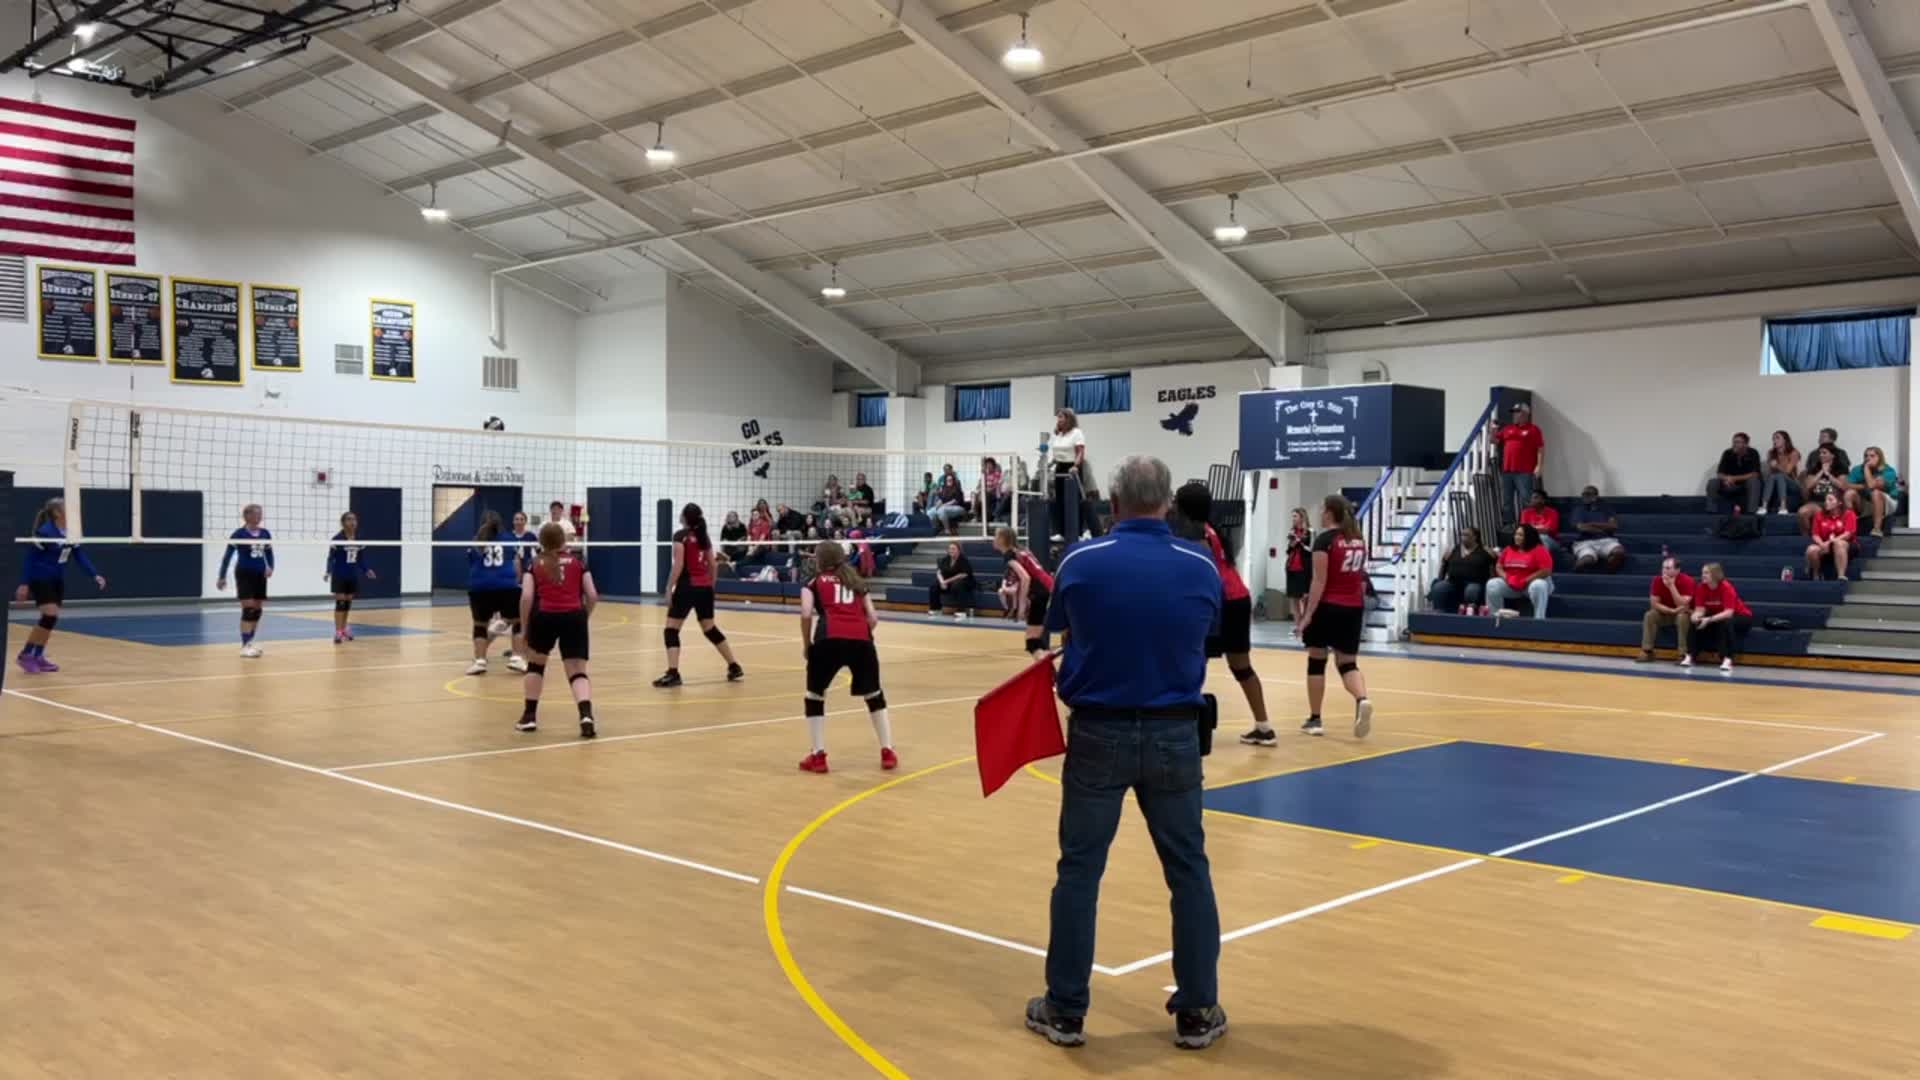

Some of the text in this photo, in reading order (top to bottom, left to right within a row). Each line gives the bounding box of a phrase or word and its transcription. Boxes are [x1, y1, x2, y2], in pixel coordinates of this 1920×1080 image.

[176, 297, 237, 313] CHAMPIONS
[1158, 385, 1216, 403] EAGLES
[741, 419, 760, 440] GO
[483, 545, 504, 568] 33
[1341, 550, 1363, 572] 20
